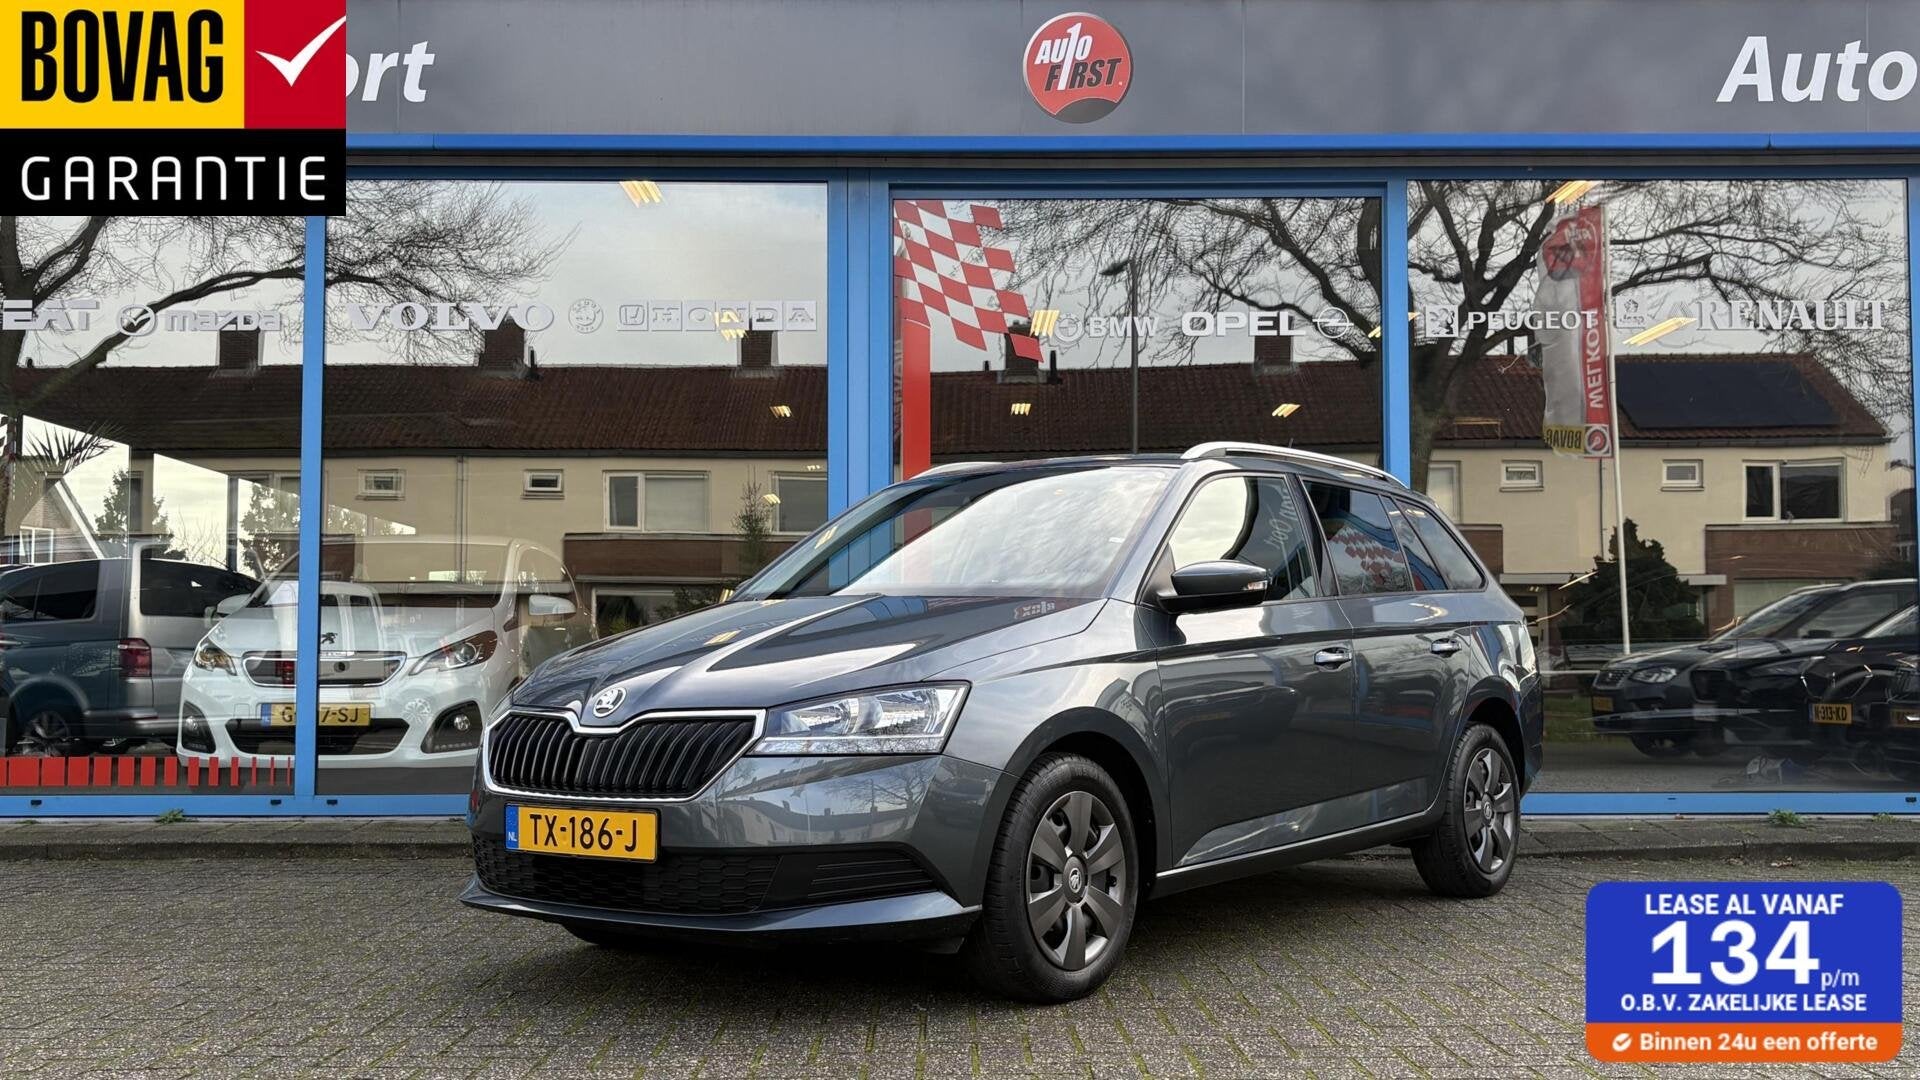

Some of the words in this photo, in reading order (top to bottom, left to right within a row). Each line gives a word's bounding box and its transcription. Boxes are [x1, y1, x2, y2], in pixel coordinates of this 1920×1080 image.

[1716, 36, 1918, 102] Auto
[347, 300, 555, 331] VOLVO
[651, 303, 816, 327] HONDA
[1089, 316, 1160, 337] BMW
[1181, 311, 1306, 336] OPEL
[1467, 311, 1598, 331] PEUGEOT
[1697, 300, 1889, 331] RENAULT
[529, 813, 638, 852] TX-186-J
